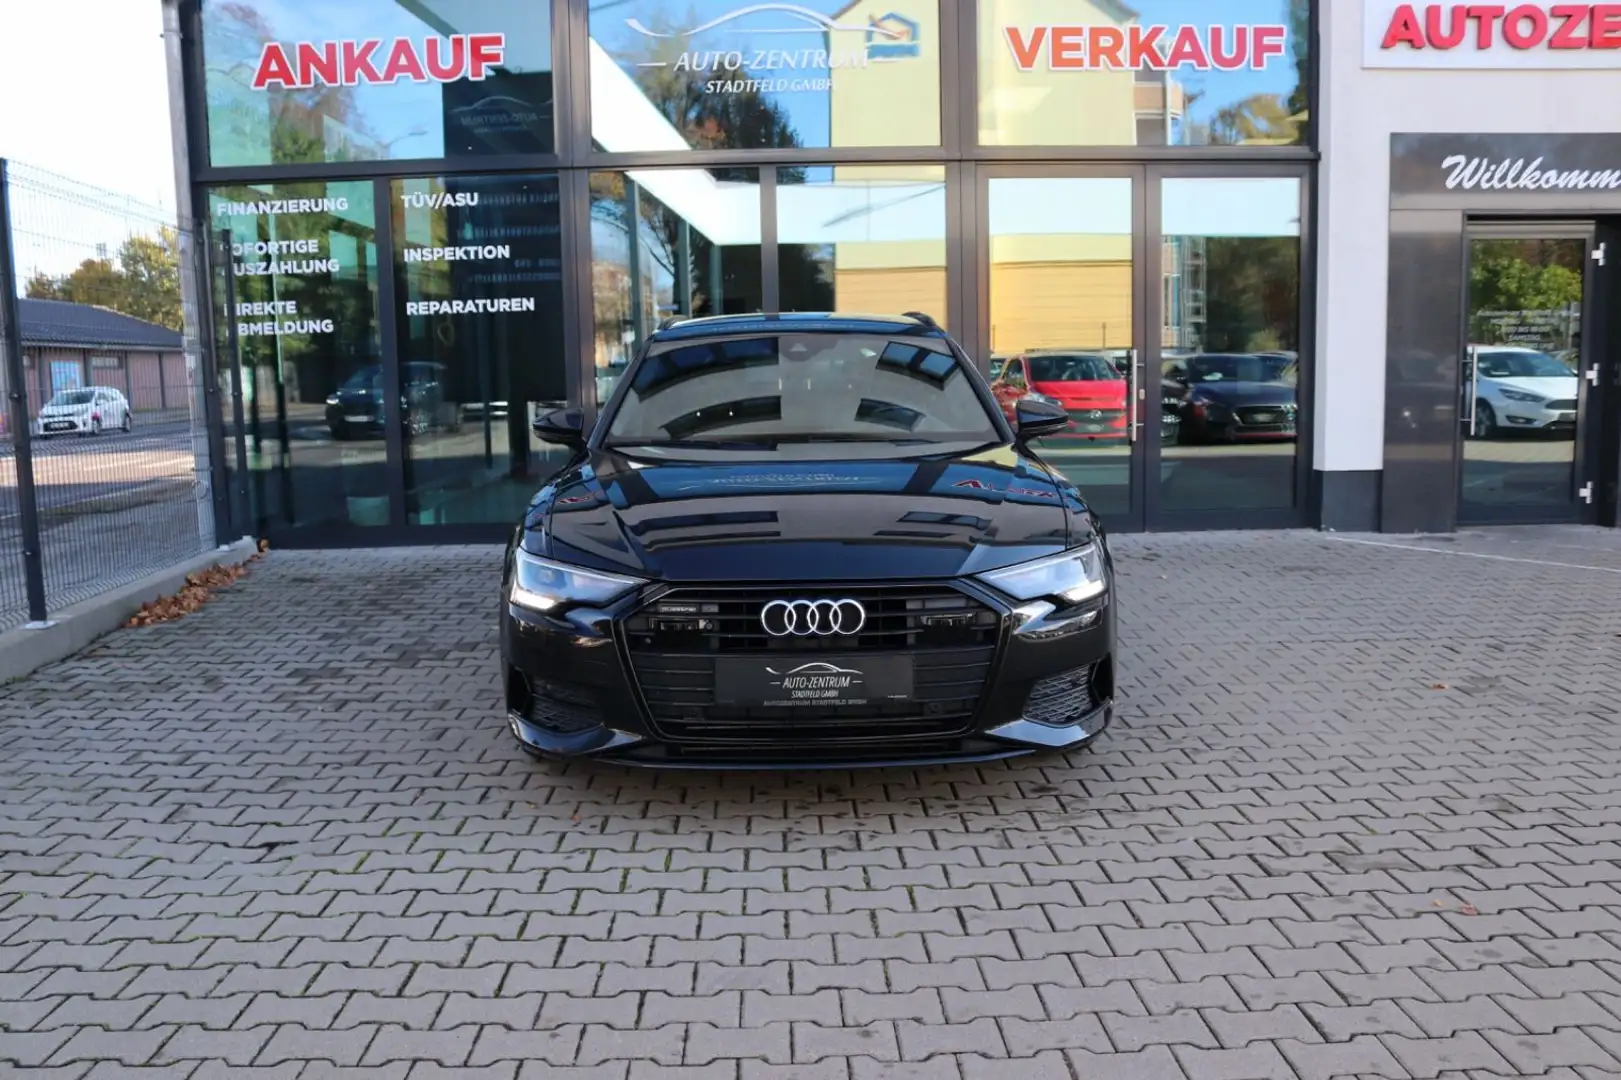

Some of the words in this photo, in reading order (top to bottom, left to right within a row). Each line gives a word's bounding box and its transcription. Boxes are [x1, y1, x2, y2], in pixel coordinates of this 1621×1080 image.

[1380, 4, 1621, 49] AUTOZE
[1003, 24, 1286, 71] VERKAUF
[251, 33, 504, 91] ANKAUF
[673, 48, 869, 72] AUTO-ZENTRUM
[706, 79, 788, 94] STADTFELD
[1441, 154, 1621, 190] Willkomm
[217, 198, 349, 216] FINANZIERUNG
[401, 192, 479, 209] TÜV/ASU
[220, 239, 319, 257] OFORTIGE
[404, 245, 510, 262] INSPEKTION
[222, 259, 340, 277] USZAHLUNG
[224, 301, 297, 317] IREKTE
[406, 297, 535, 316] REPARATUREN
[226, 319, 334, 337] BMELDUNG
[782, 676, 851, 689] AUTO-ZENTRUM
[791, 690, 820, 698] STADTFELD
